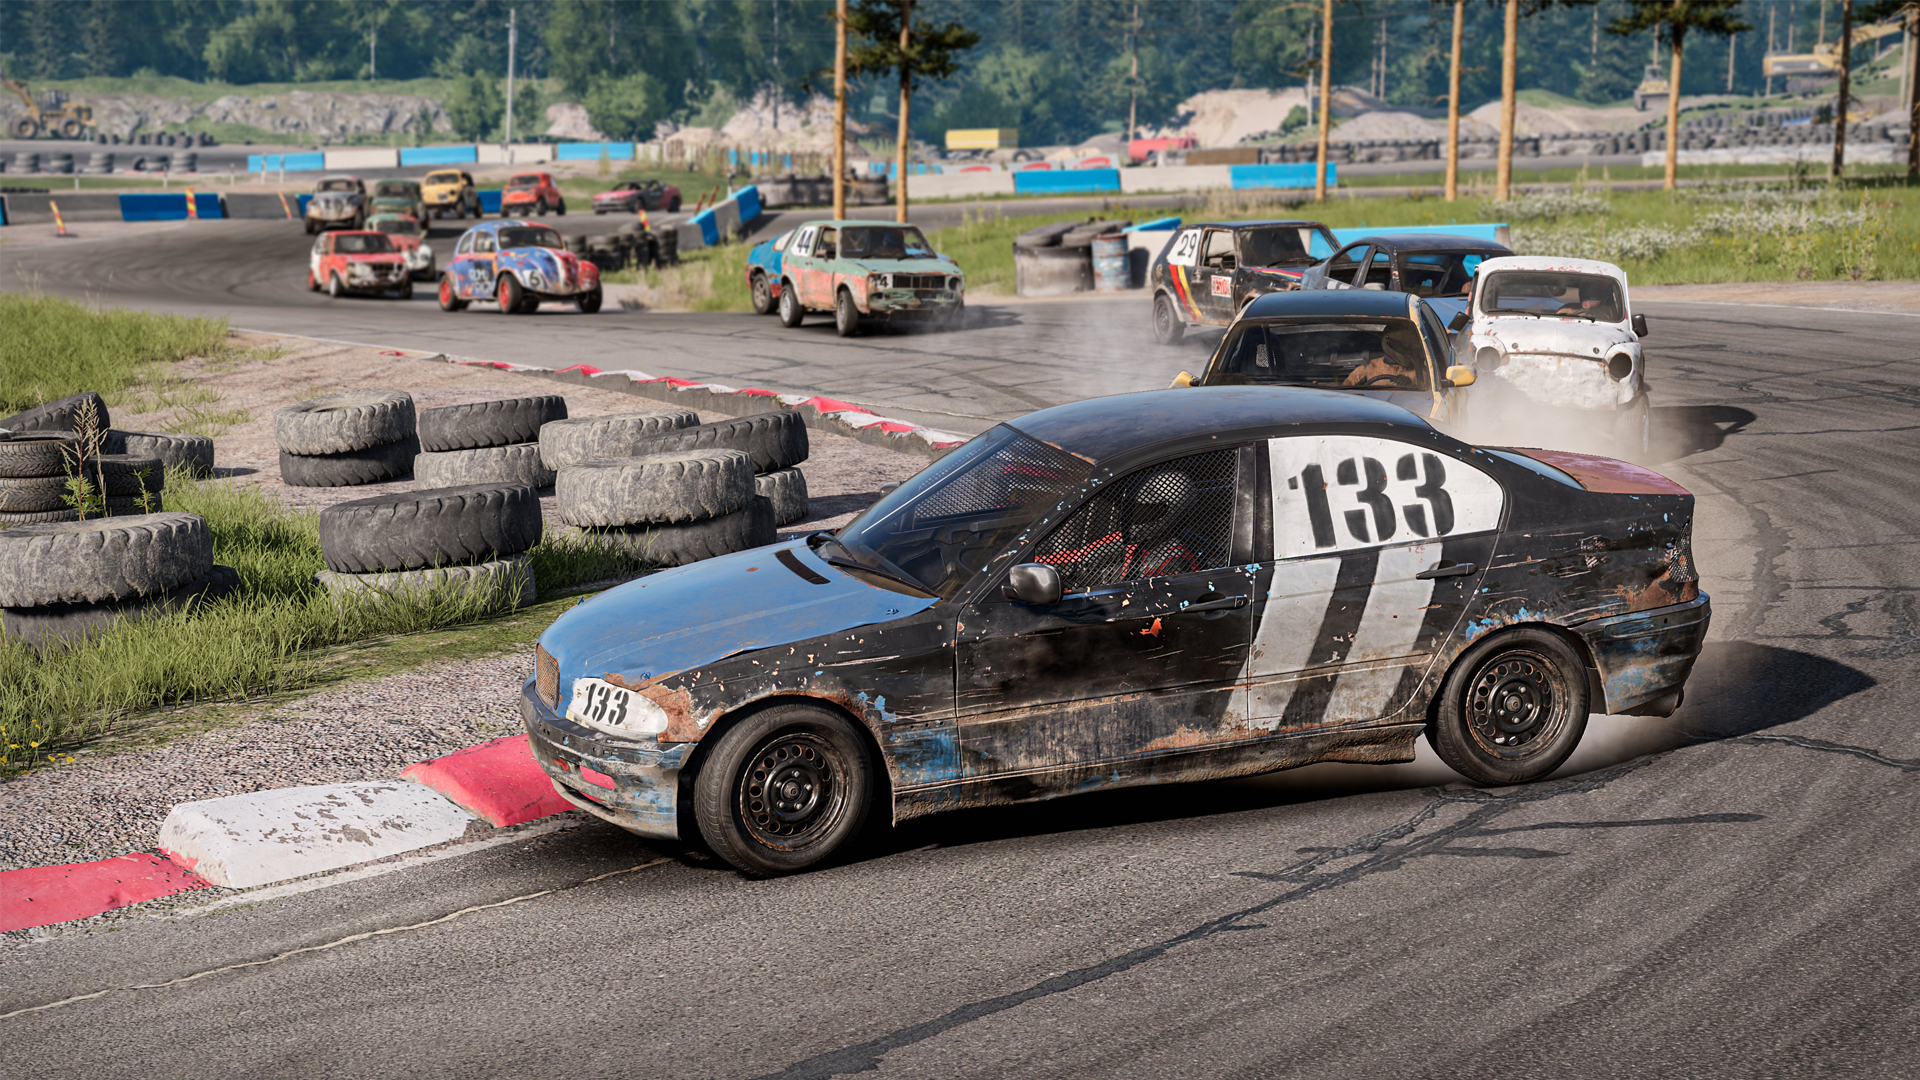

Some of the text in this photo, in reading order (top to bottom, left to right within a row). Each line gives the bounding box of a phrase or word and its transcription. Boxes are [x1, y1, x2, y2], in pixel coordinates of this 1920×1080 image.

[797, 230, 814, 254] 44
[1177, 233, 1197, 258] 29
[530, 271, 541, 286] 6
[1287, 452, 1455, 548] 133
[583, 683, 629, 725] 133
